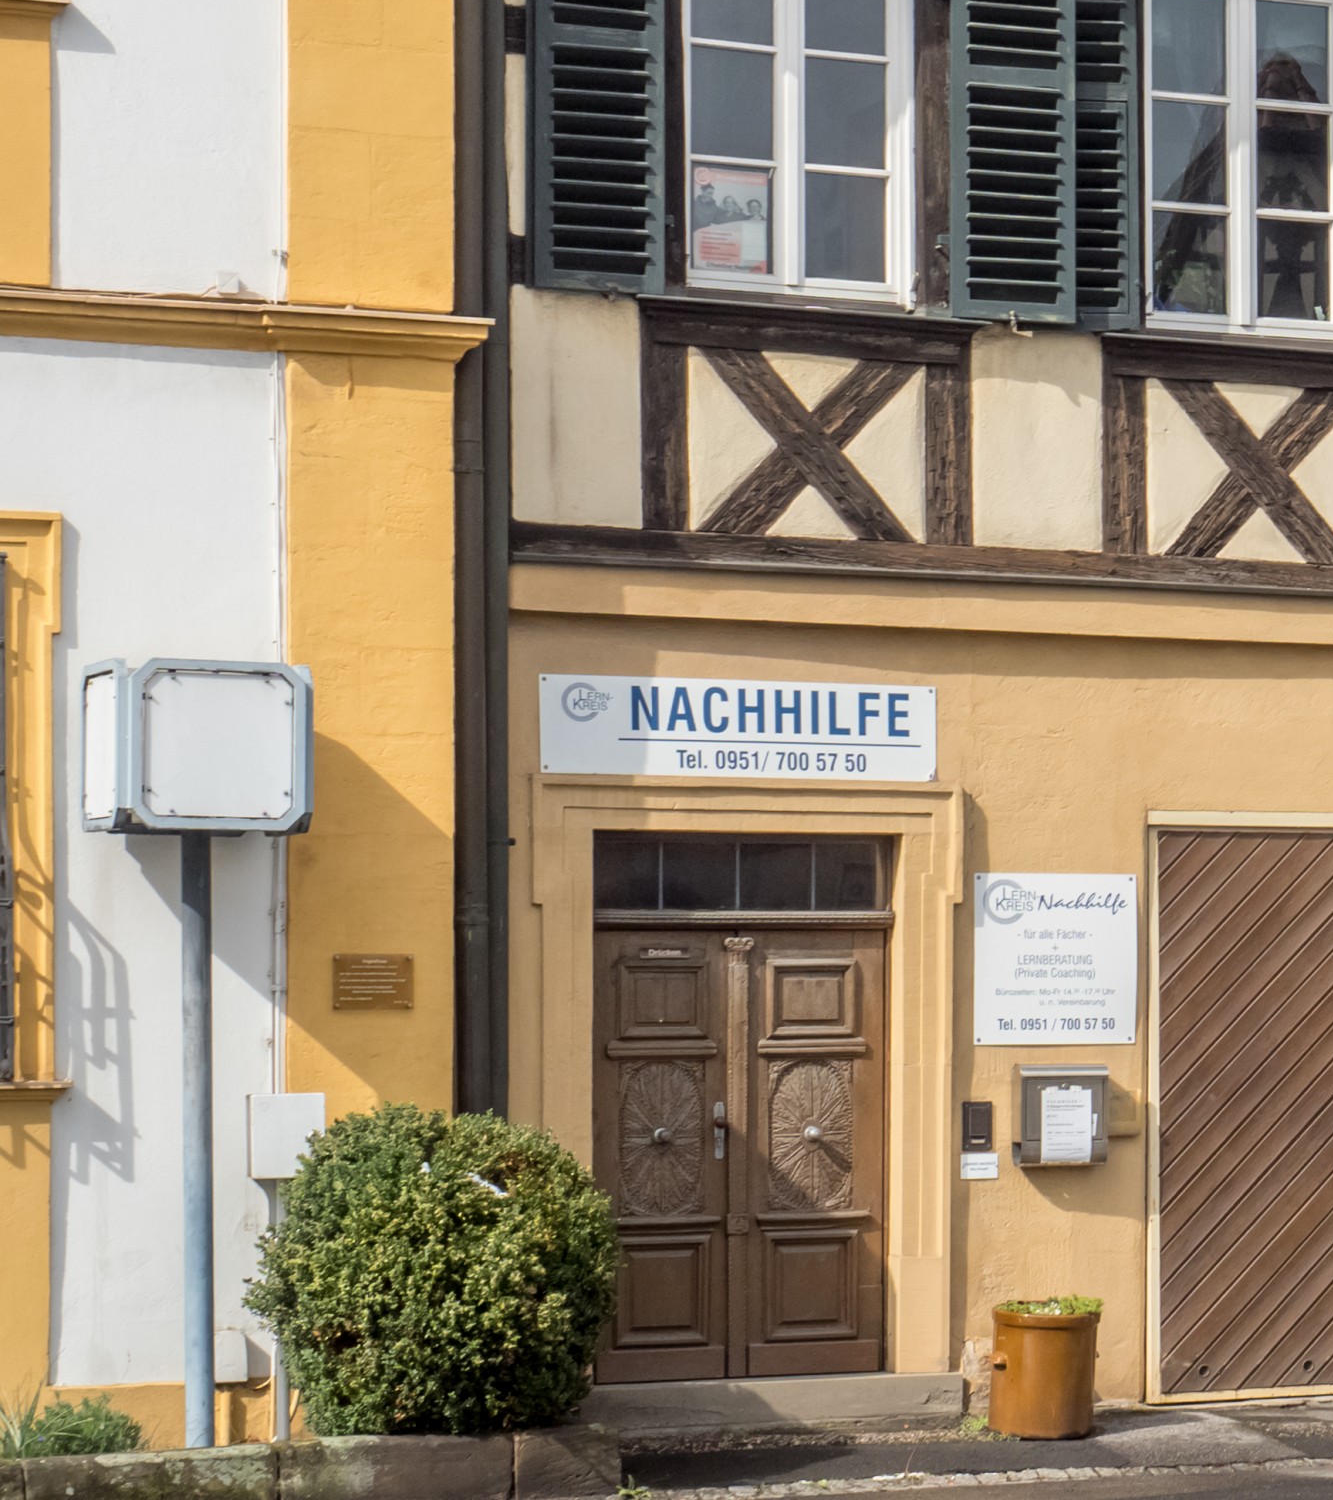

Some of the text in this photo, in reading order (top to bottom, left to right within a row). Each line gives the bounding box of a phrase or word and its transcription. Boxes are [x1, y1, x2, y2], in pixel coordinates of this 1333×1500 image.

[573, 698, 608, 711] KREIS
[631, 685, 911, 737] NACHHILFE
[676, 750, 708, 769] Tel.
[776, 752, 809, 771] 700
[816, 753, 838, 772] 57
[845, 754, 867, 773] 50
[995, 898, 1034, 912] KREIS
[1038, 892, 1128, 915] Nachhilfe
[1039, 929, 1054, 939] alle
[1017, 955, 1093, 965] LERNBERATUNG
[1014, 968, 1096, 980] (Private Coaching)
[997, 1018, 1017, 1031] Tel.
[1020, 1018, 1048, 1031] 0951
[1060, 1018, 1081, 1030] 700
[1084, 1018, 1098, 1030] 57
[1101, 1018, 1115, 1030] 50
